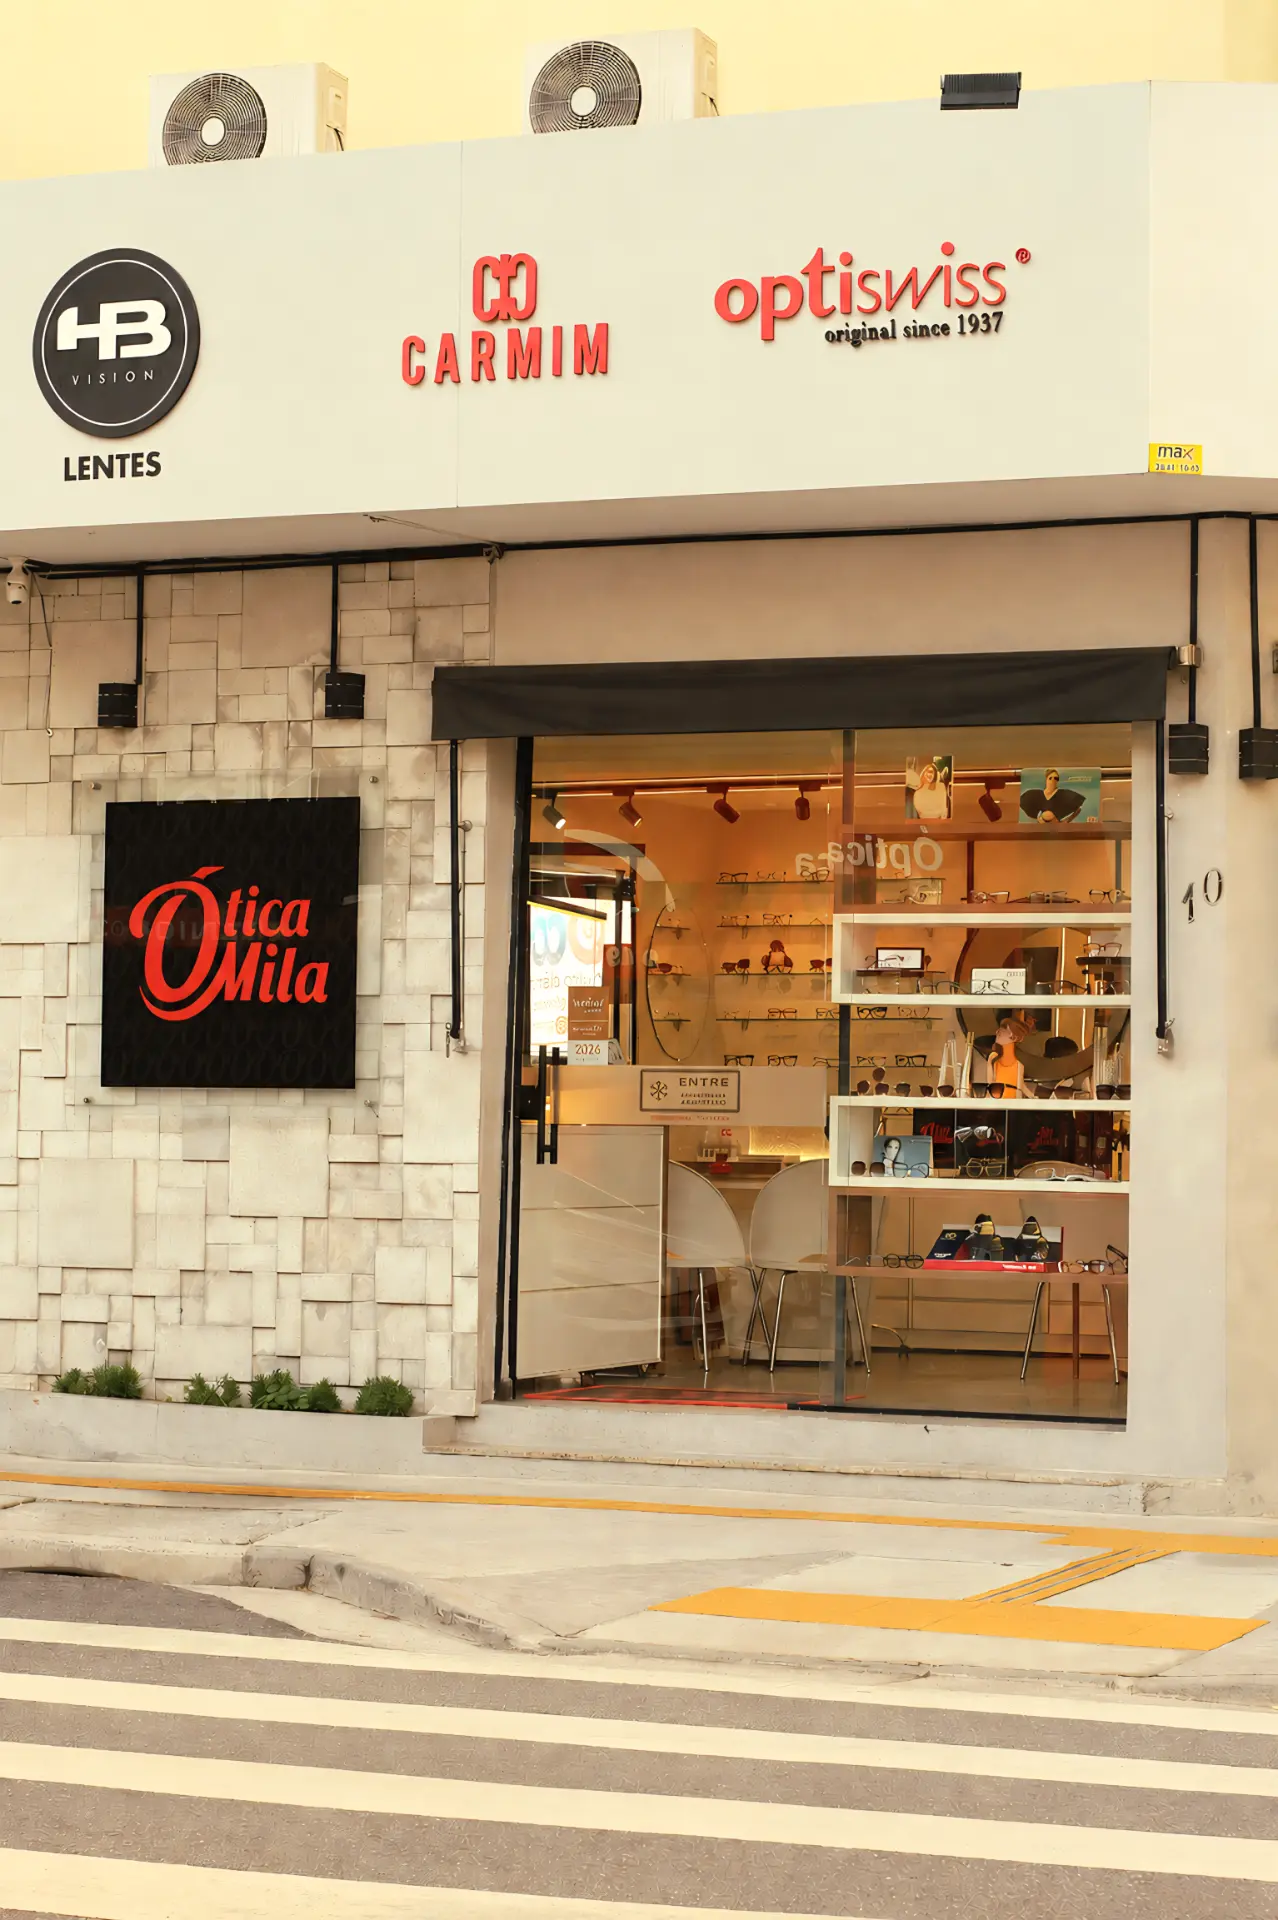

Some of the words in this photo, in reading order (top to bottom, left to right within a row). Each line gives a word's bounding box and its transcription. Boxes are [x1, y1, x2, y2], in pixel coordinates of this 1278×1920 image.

[714, 241, 1007, 340] optiswiss
[57, 300, 172, 360] HB
[825, 319, 897, 347] original
[903, 320, 951, 338] since
[957, 311, 1004, 334] 1937
[402, 323, 608, 386] CARMIM
[72, 370, 155, 386] VISION
[64, 451, 162, 481] LENTES
[1158, 446, 1194, 460] max
[129, 866, 312, 1003] Ótica
[205, 941, 330, 1006] Mila
[575, 1044, 601, 1055] 2026
[679, 1077, 729, 1087] ENTRE
